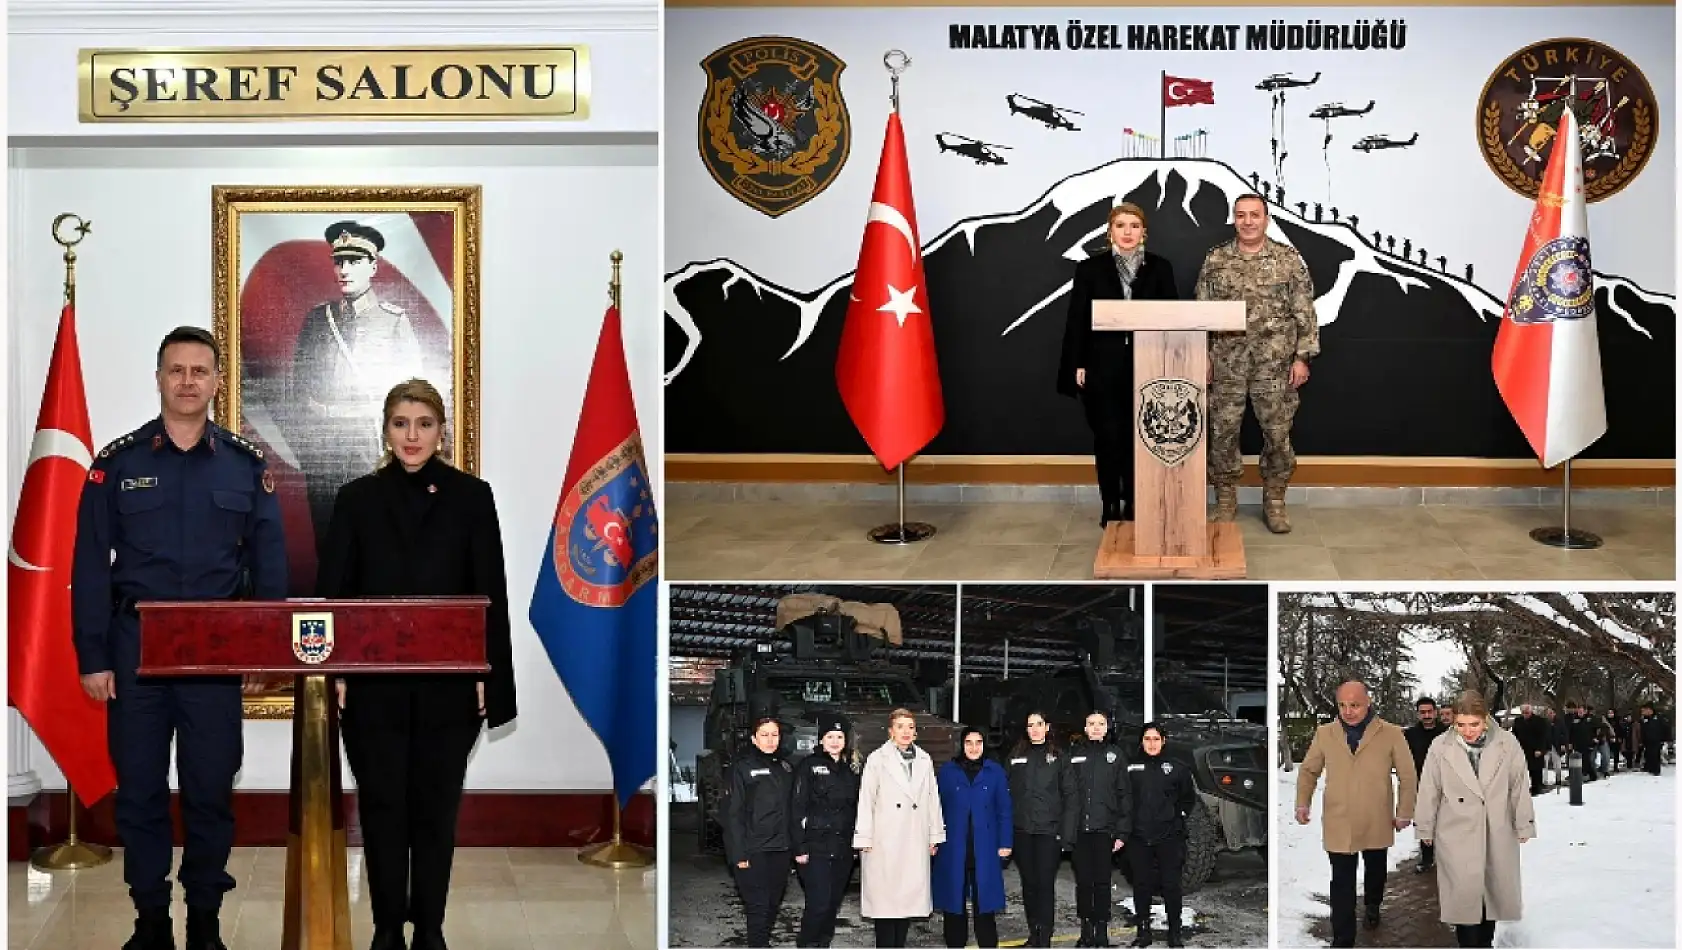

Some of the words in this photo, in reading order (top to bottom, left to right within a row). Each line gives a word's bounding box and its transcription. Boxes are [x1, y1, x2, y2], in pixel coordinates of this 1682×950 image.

[949, 24, 1061, 51] MALATYA
[1066, 19, 1123, 51] ÖZEL
[1127, 24, 1241, 51] HAREKAT
[1245, 19, 1407, 51] MÜDÜRLÜĞÜ
[110, 66, 298, 112] ŞEREF
[316, 64, 558, 101] SALONU
